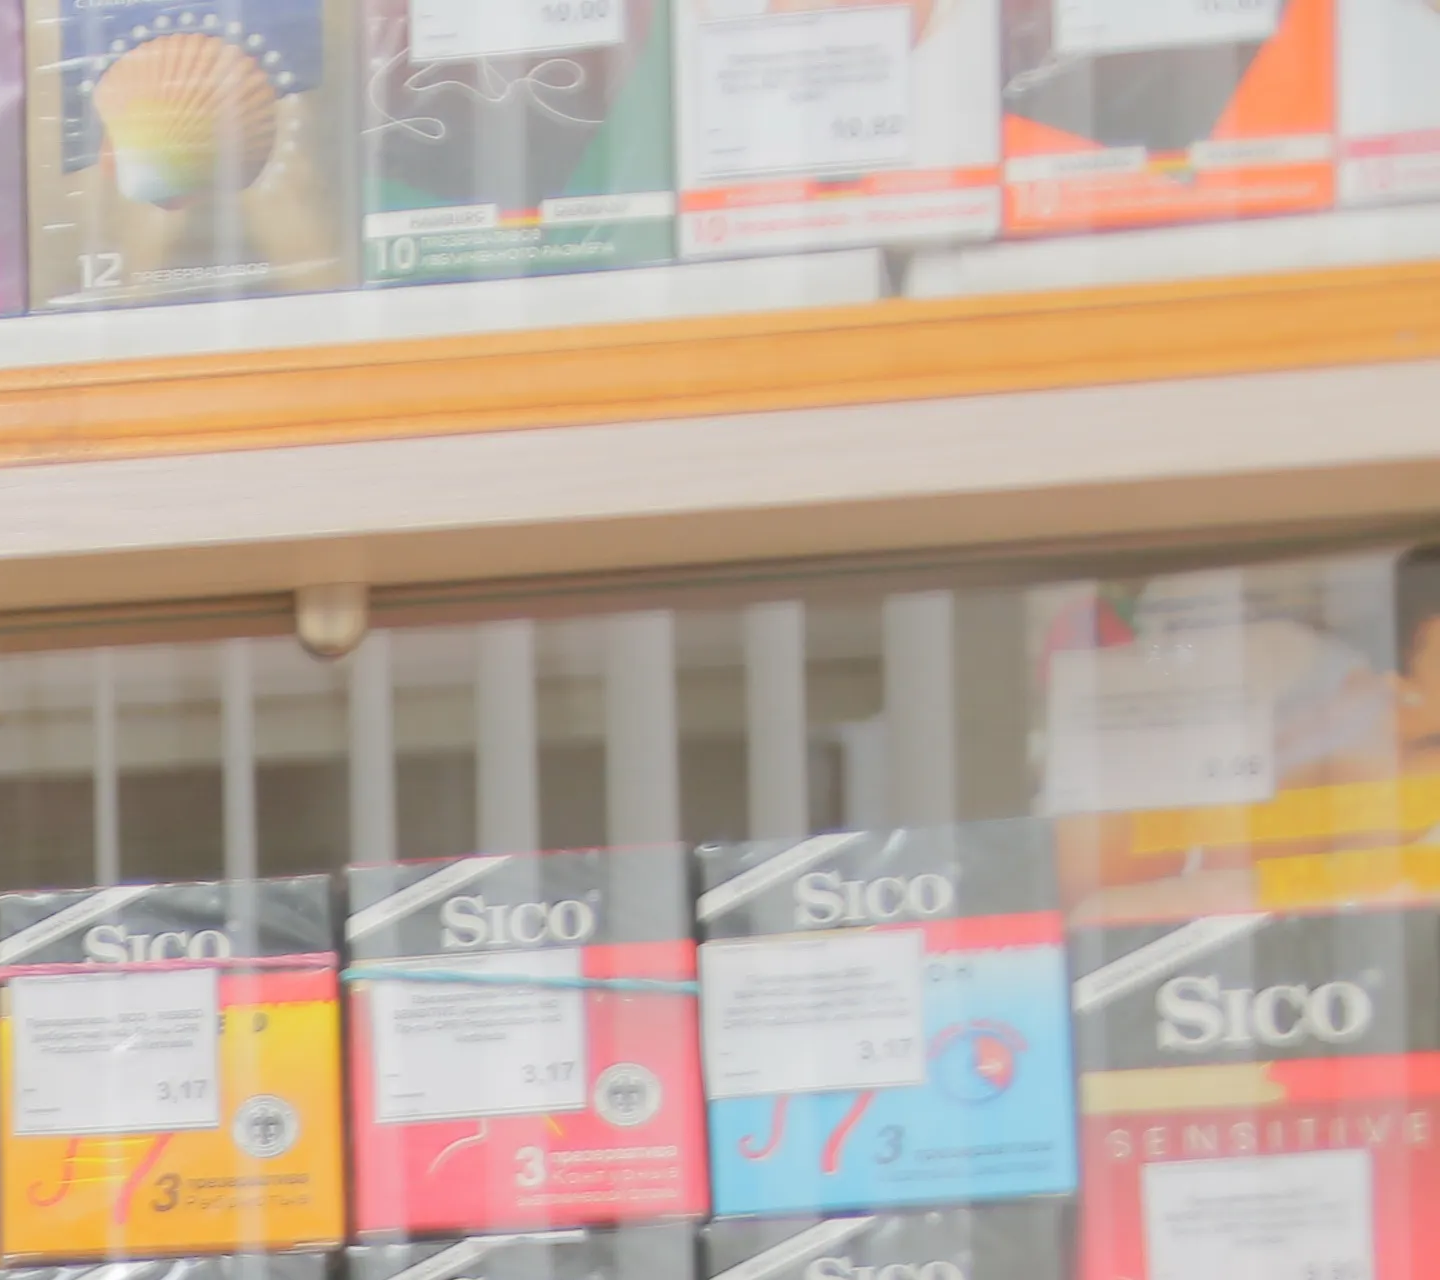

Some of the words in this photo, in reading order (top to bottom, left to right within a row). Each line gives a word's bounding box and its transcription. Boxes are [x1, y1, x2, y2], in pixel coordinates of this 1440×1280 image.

[77, 252, 124, 290] 12
[376, 237, 418, 274] 10
[156, 1079, 208, 1104] 3,17
[873, 1123, 907, 1165] 3
[1103, 1108, 1432, 1162] SENSITIVE
[515, 1146, 546, 1188] 3
[148, 1172, 183, 1213] 3
